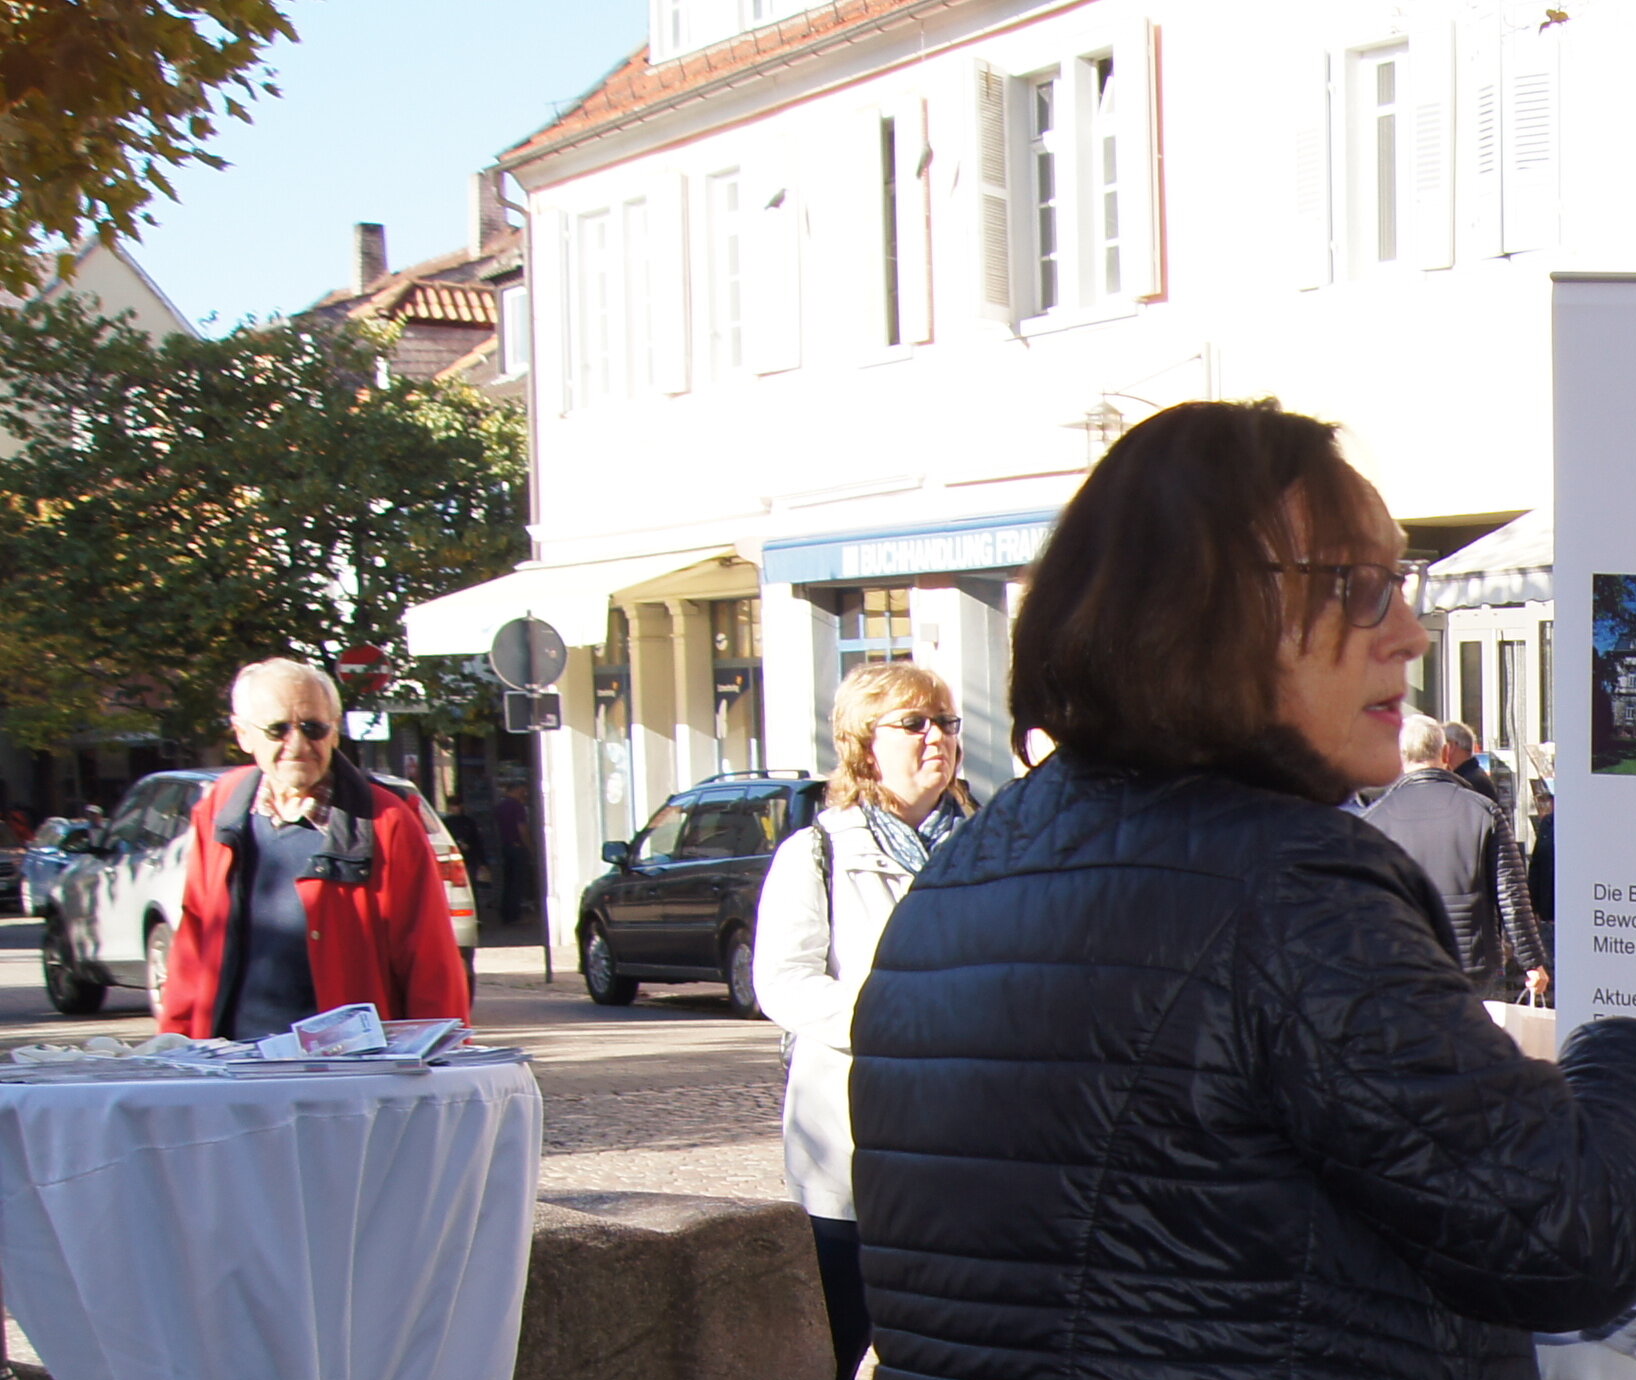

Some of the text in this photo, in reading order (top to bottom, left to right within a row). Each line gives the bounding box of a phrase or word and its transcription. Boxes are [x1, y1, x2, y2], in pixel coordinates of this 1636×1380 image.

[860, 527, 1050, 576] BUCHHANDLUNG FRAN
[1593, 883, 1622, 901] Die
